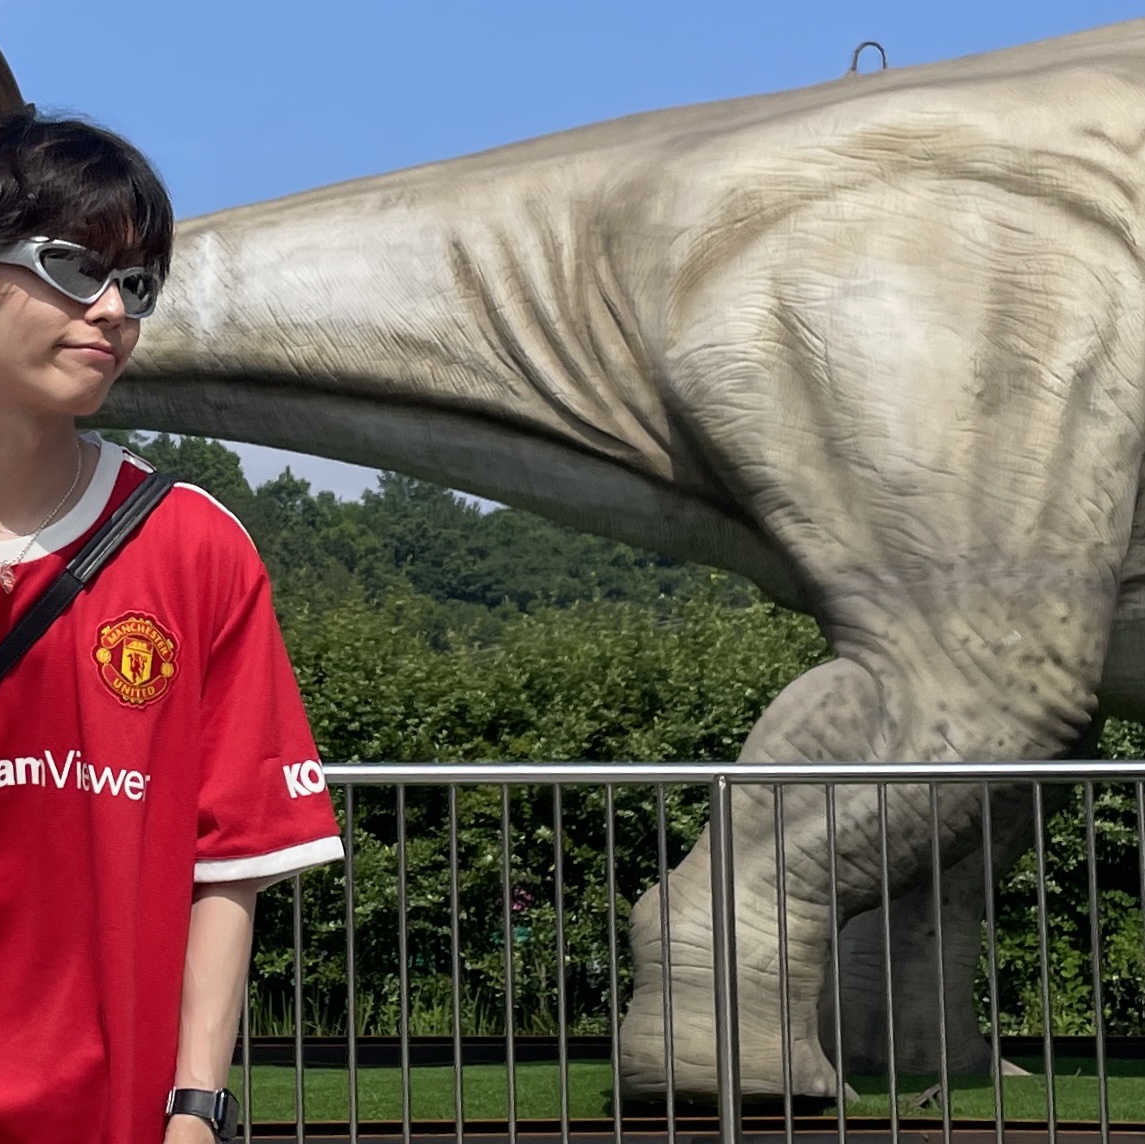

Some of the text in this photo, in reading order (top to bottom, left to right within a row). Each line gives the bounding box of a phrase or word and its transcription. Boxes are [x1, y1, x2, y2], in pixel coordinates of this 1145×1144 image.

[107, 623, 169, 656] MANCHESTER
[113, 678, 155, 696] UNITED
[283, 759, 326, 799] KO
